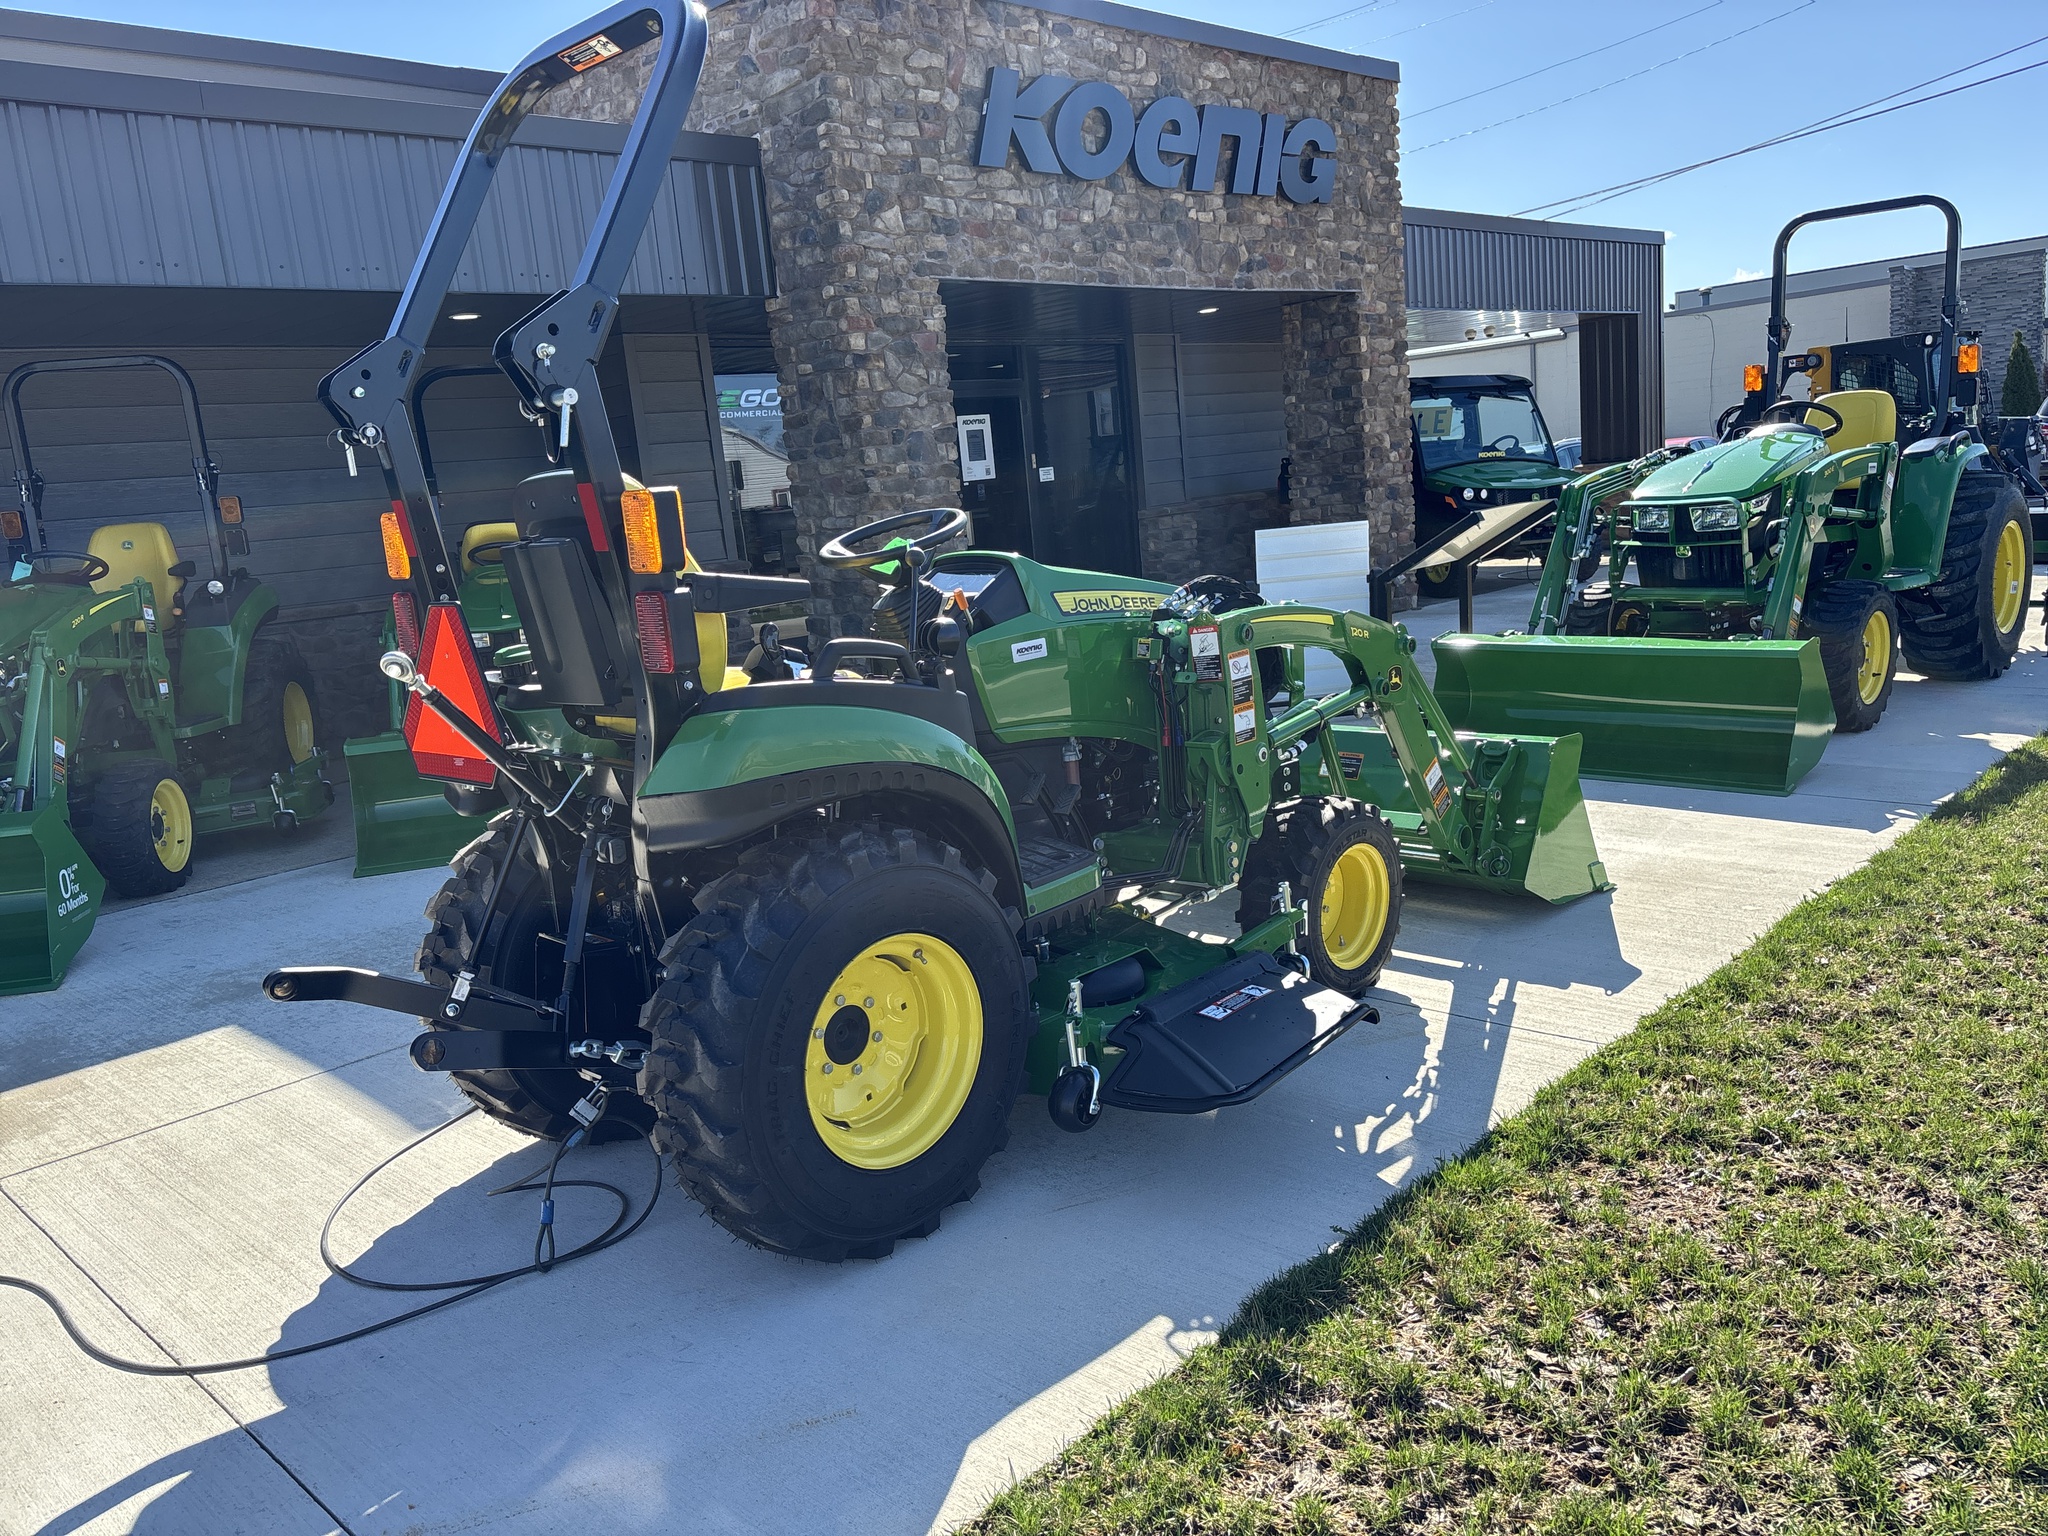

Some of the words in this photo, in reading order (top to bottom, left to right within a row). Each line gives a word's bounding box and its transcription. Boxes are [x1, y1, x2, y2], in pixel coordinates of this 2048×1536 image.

[719, 388, 782, 409] EGO
[720, 409, 784, 419] COMMERCIAL
[1070, 596, 1110, 612] JOHN
[1110, 594, 1158, 609] DEERE
[57, 902, 68, 917] 60
[66, 891, 89, 913] Months
